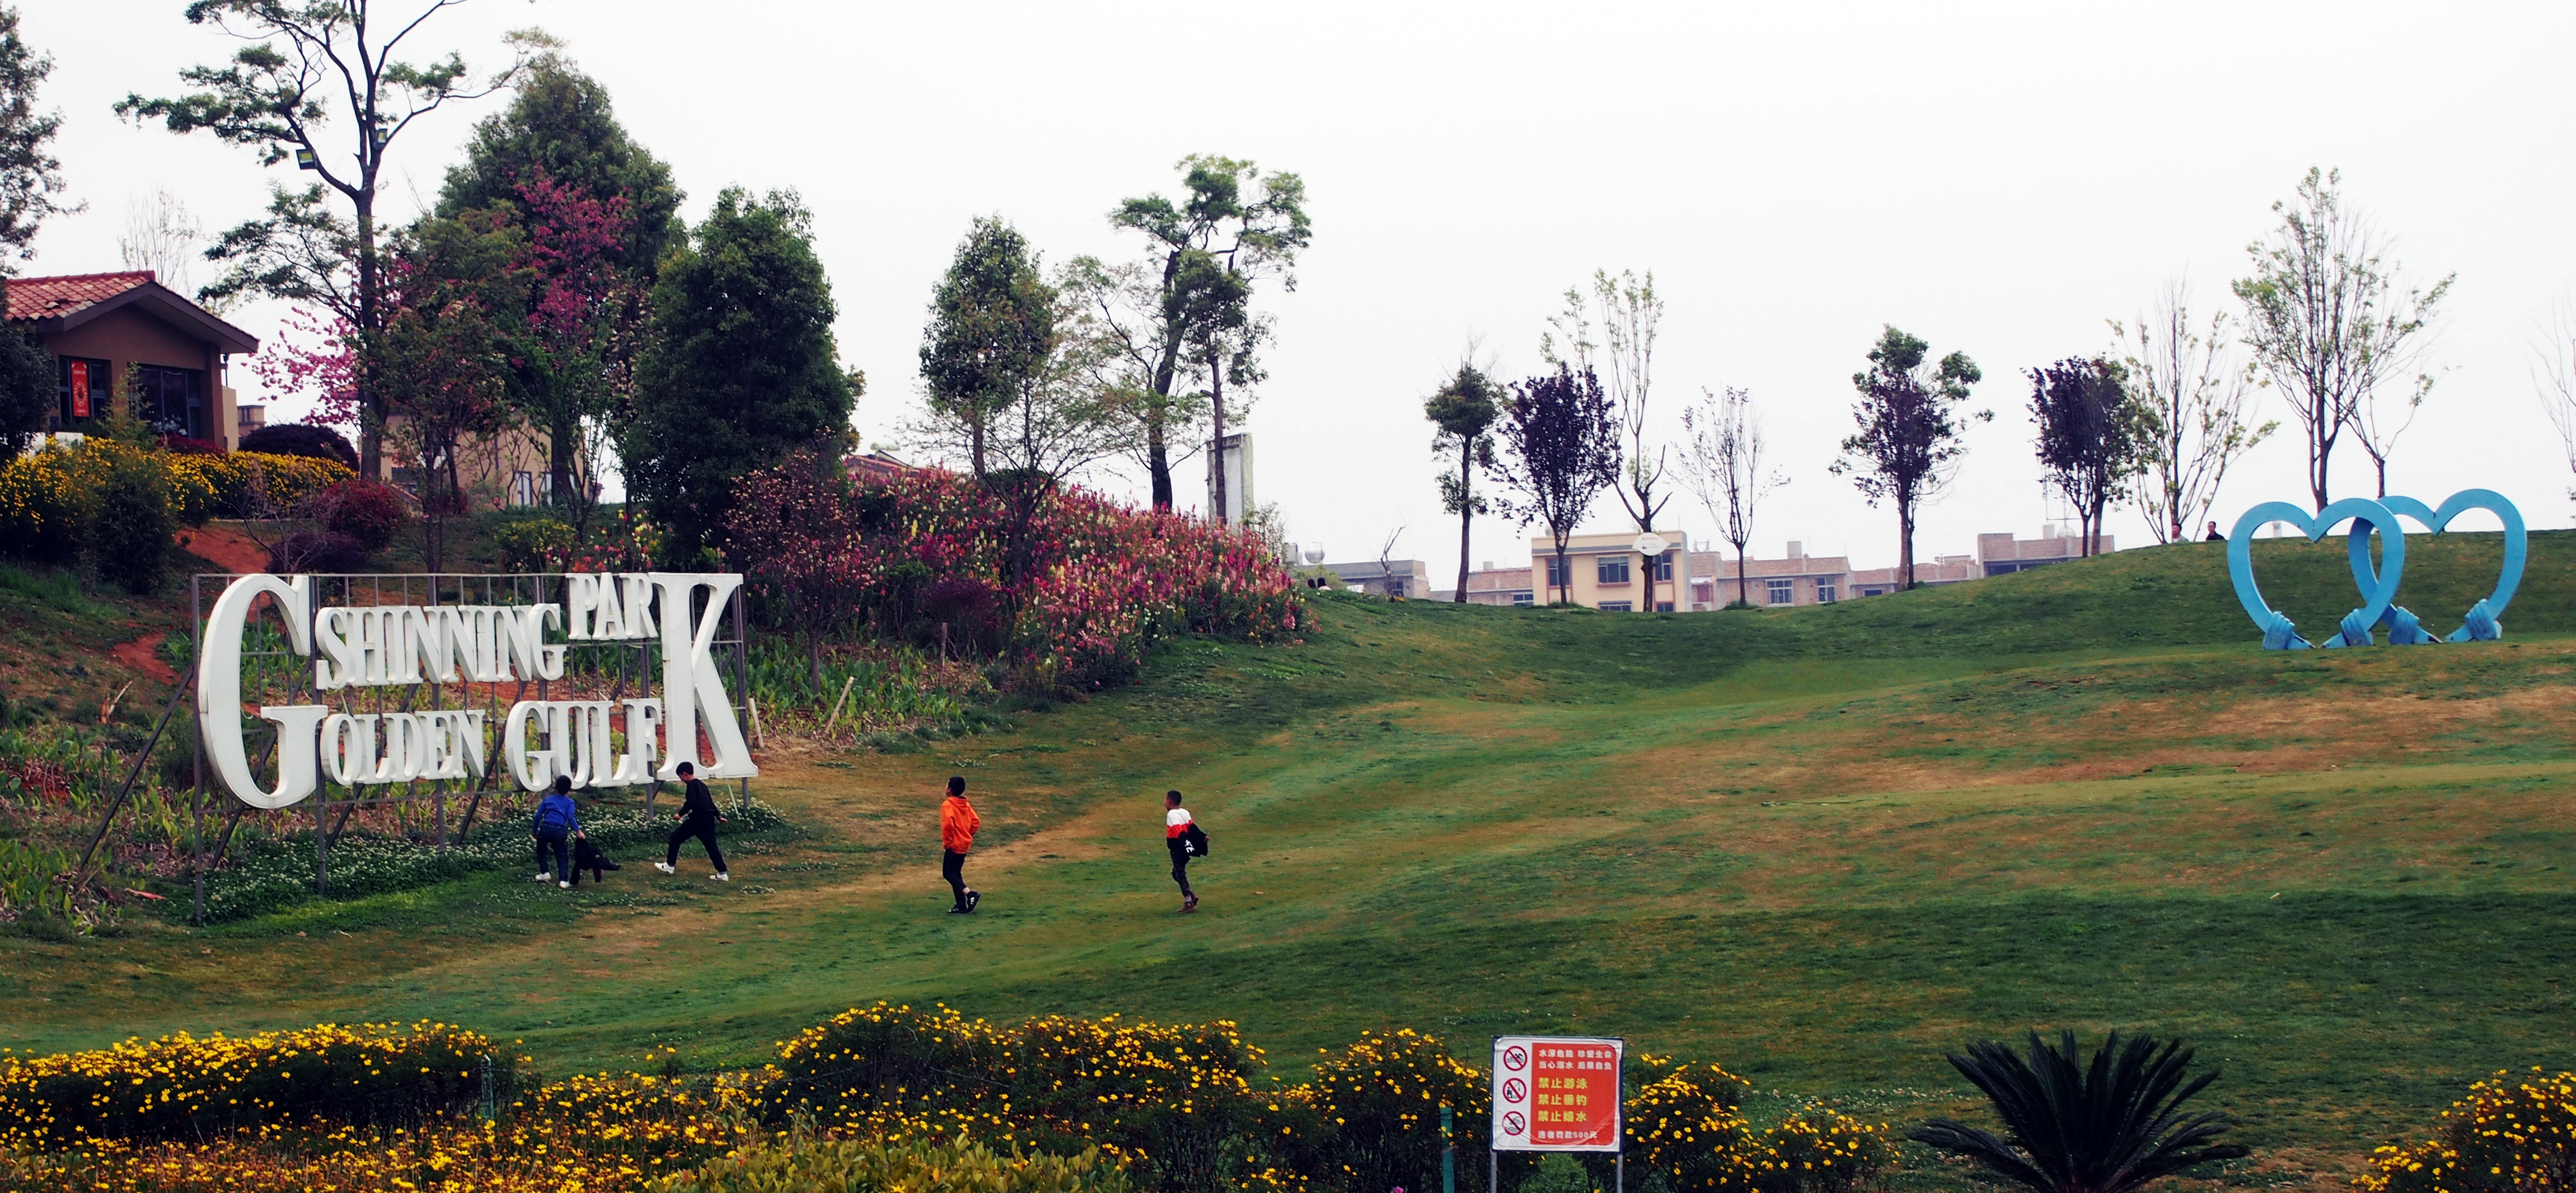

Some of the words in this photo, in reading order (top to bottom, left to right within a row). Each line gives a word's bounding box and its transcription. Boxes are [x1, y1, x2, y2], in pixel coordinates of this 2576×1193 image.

[315, 603, 567, 690] SHINNING
[505, 697, 663, 792] GULF
[1538, 1049, 1573, 1058] 水深危险
[1577, 1049, 1612, 1059] 珍爱生命
[1577, 1061, 1612, 1070] 后果自负
[1538, 1077, 1588, 1089] 禁止游泳
[1538, 1093, 1587, 1106] 禁止垂钓
[1538, 1130, 1598, 1139] 违者罚款500元
